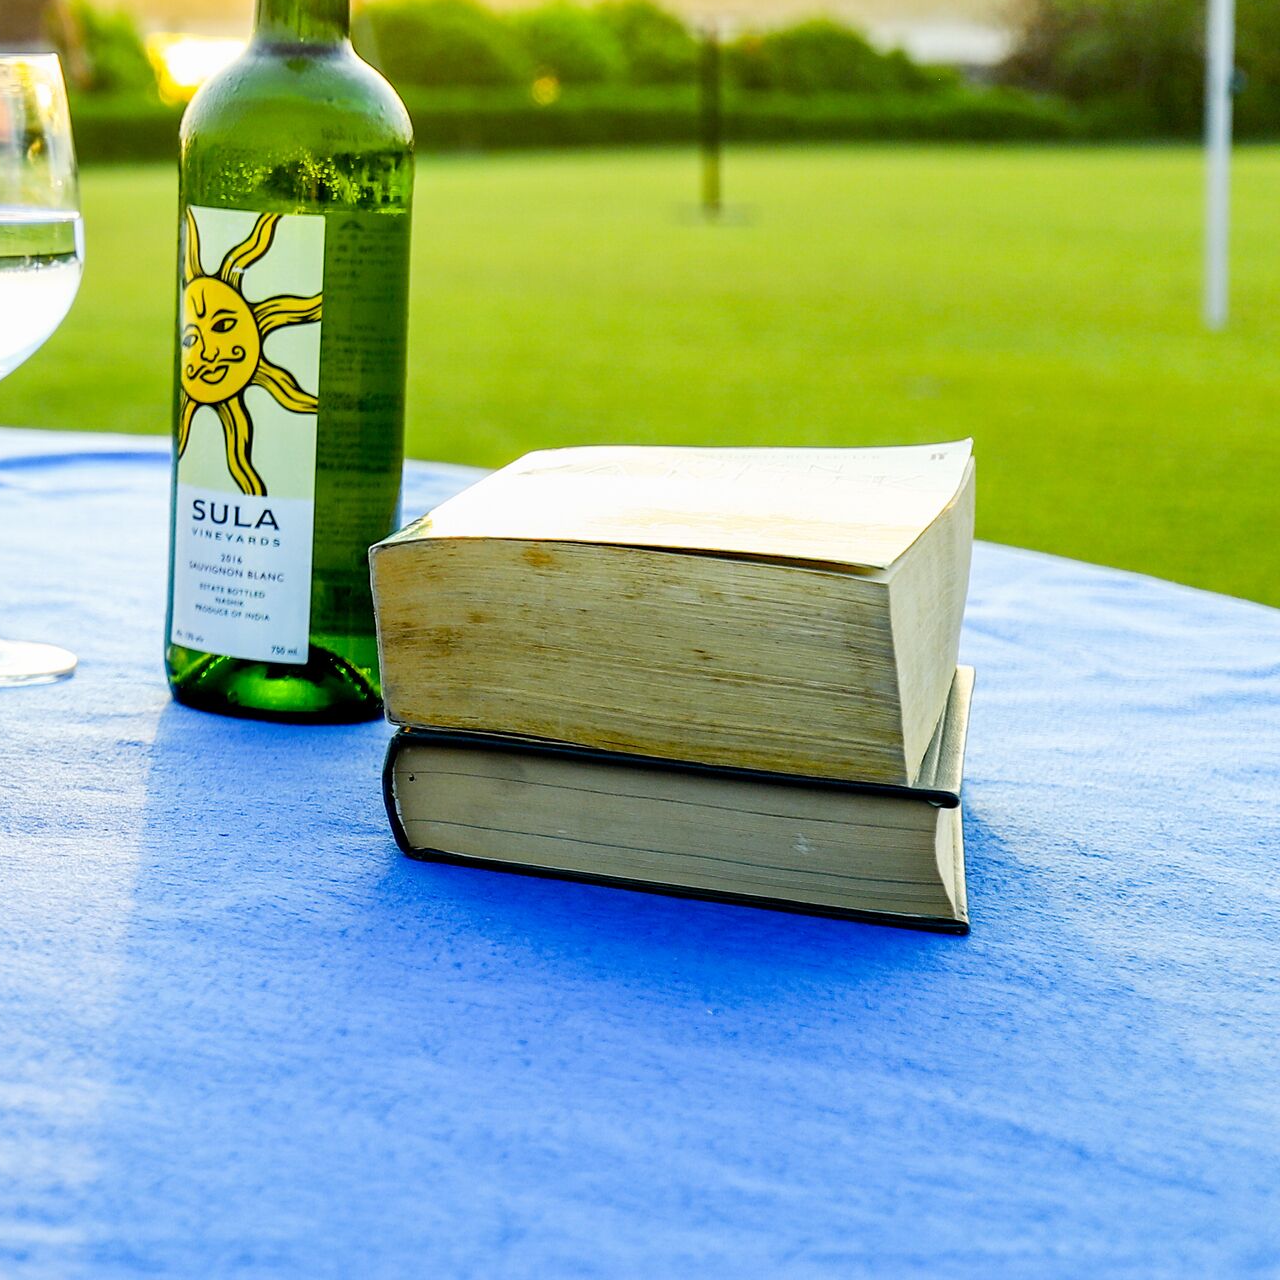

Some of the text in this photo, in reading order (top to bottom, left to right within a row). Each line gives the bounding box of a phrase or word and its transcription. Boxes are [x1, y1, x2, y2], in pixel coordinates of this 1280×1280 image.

[192, 499, 280, 531] SULA
[192, 527, 281, 548] VINEYARDS
[189, 560, 285, 583] SAUVIGNON BLANC
